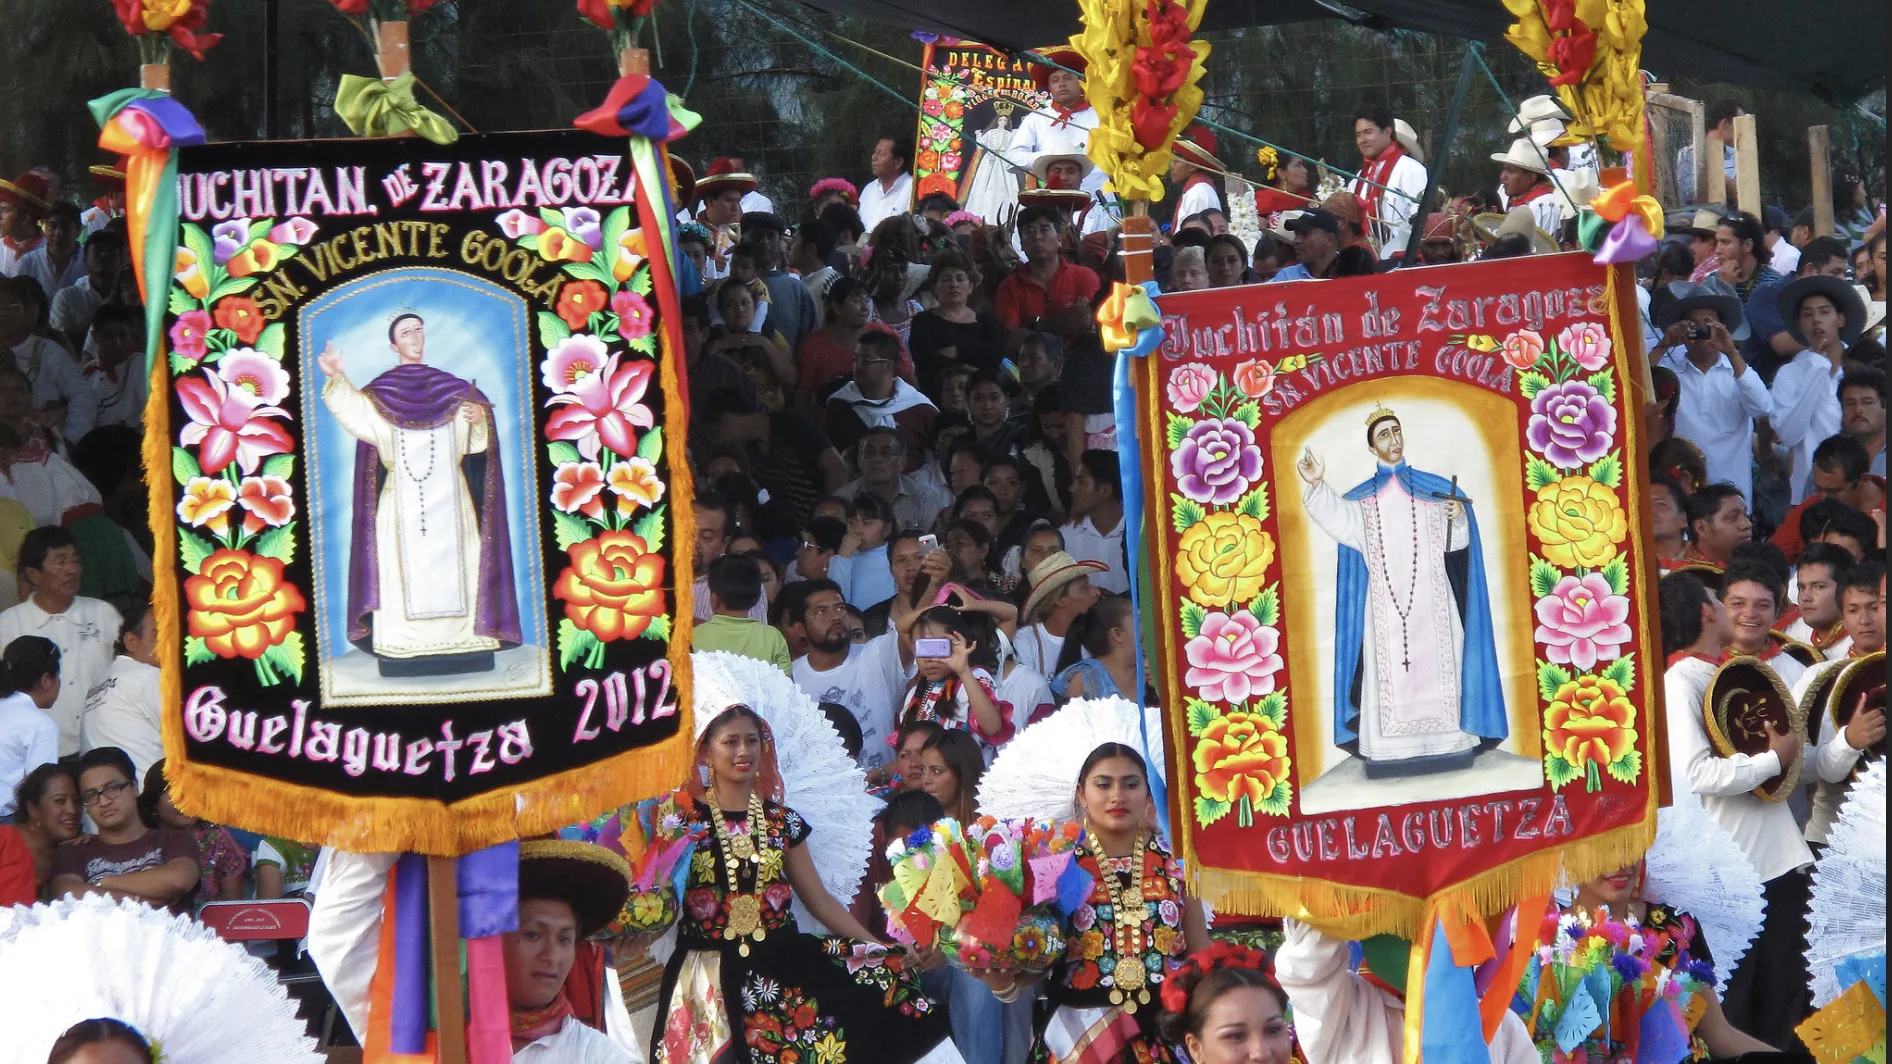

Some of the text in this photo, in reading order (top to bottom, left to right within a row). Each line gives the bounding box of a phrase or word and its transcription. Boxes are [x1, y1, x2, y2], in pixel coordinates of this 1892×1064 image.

[1010, 89, 1040, 111] ROSAR
[381, 162, 419, 208] DE
[251, 267, 308, 319] SN.
[294, 221, 451, 282] VICENTE
[1361, 290, 1401, 339] de
[1262, 340, 1516, 416] SN. VICENTE GOOLA
[184, 658, 678, 783] Guelaguetza 2012
[1266, 794, 1574, 865] GUELAGUETZA
